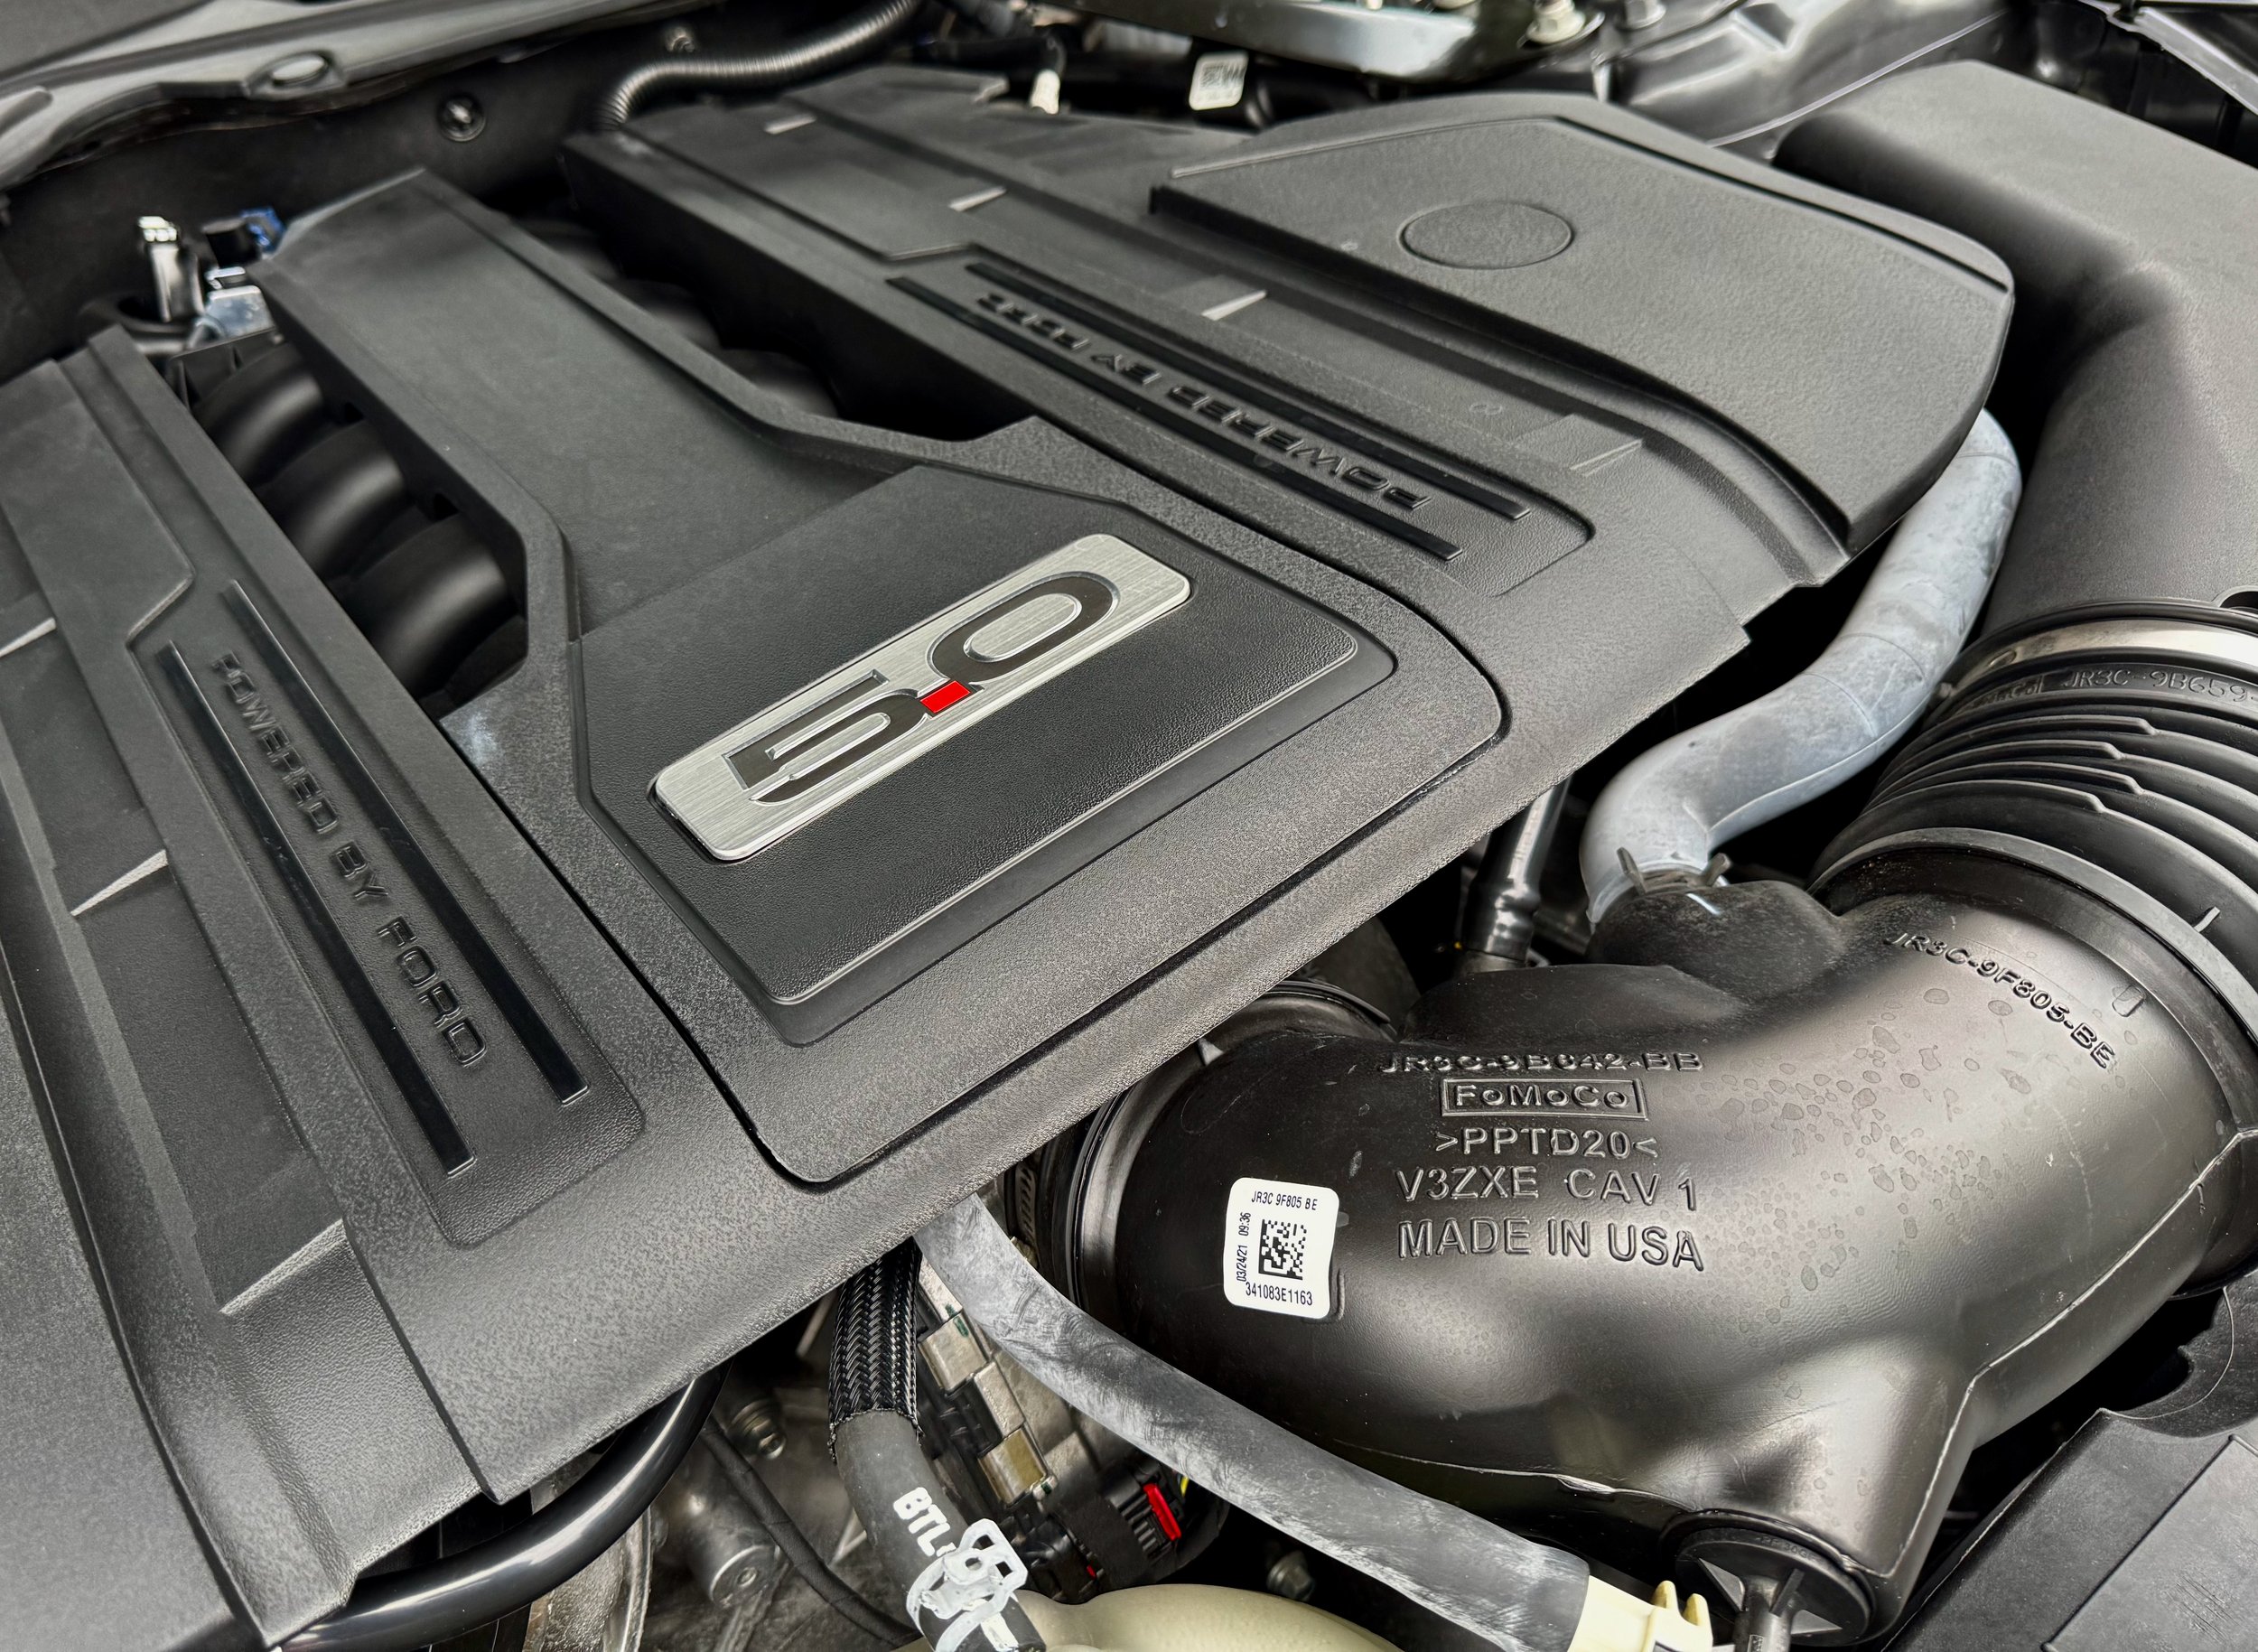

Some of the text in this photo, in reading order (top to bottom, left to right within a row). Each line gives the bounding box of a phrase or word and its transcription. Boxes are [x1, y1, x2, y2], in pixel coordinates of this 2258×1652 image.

[1166, 384, 1432, 511] POWERED
[722, 571, 1122, 806] 5.0
[211, 652, 488, 1068] POWERED BY FORD
[1455, 1084, 1628, 1109] FoMoCo
[1251, 1190, 1274, 1205] JR3C
[1275, 1192, 1302, 1209] 9F805
[1395, 1165, 1697, 1212] V3ZXE CAV 1
[1236, 1212, 1252, 1283] 03/24/21 09:36
[1398, 1216, 1705, 1272] MADE IN USA
[1246, 1281, 1313, 1306] 341083E1163
